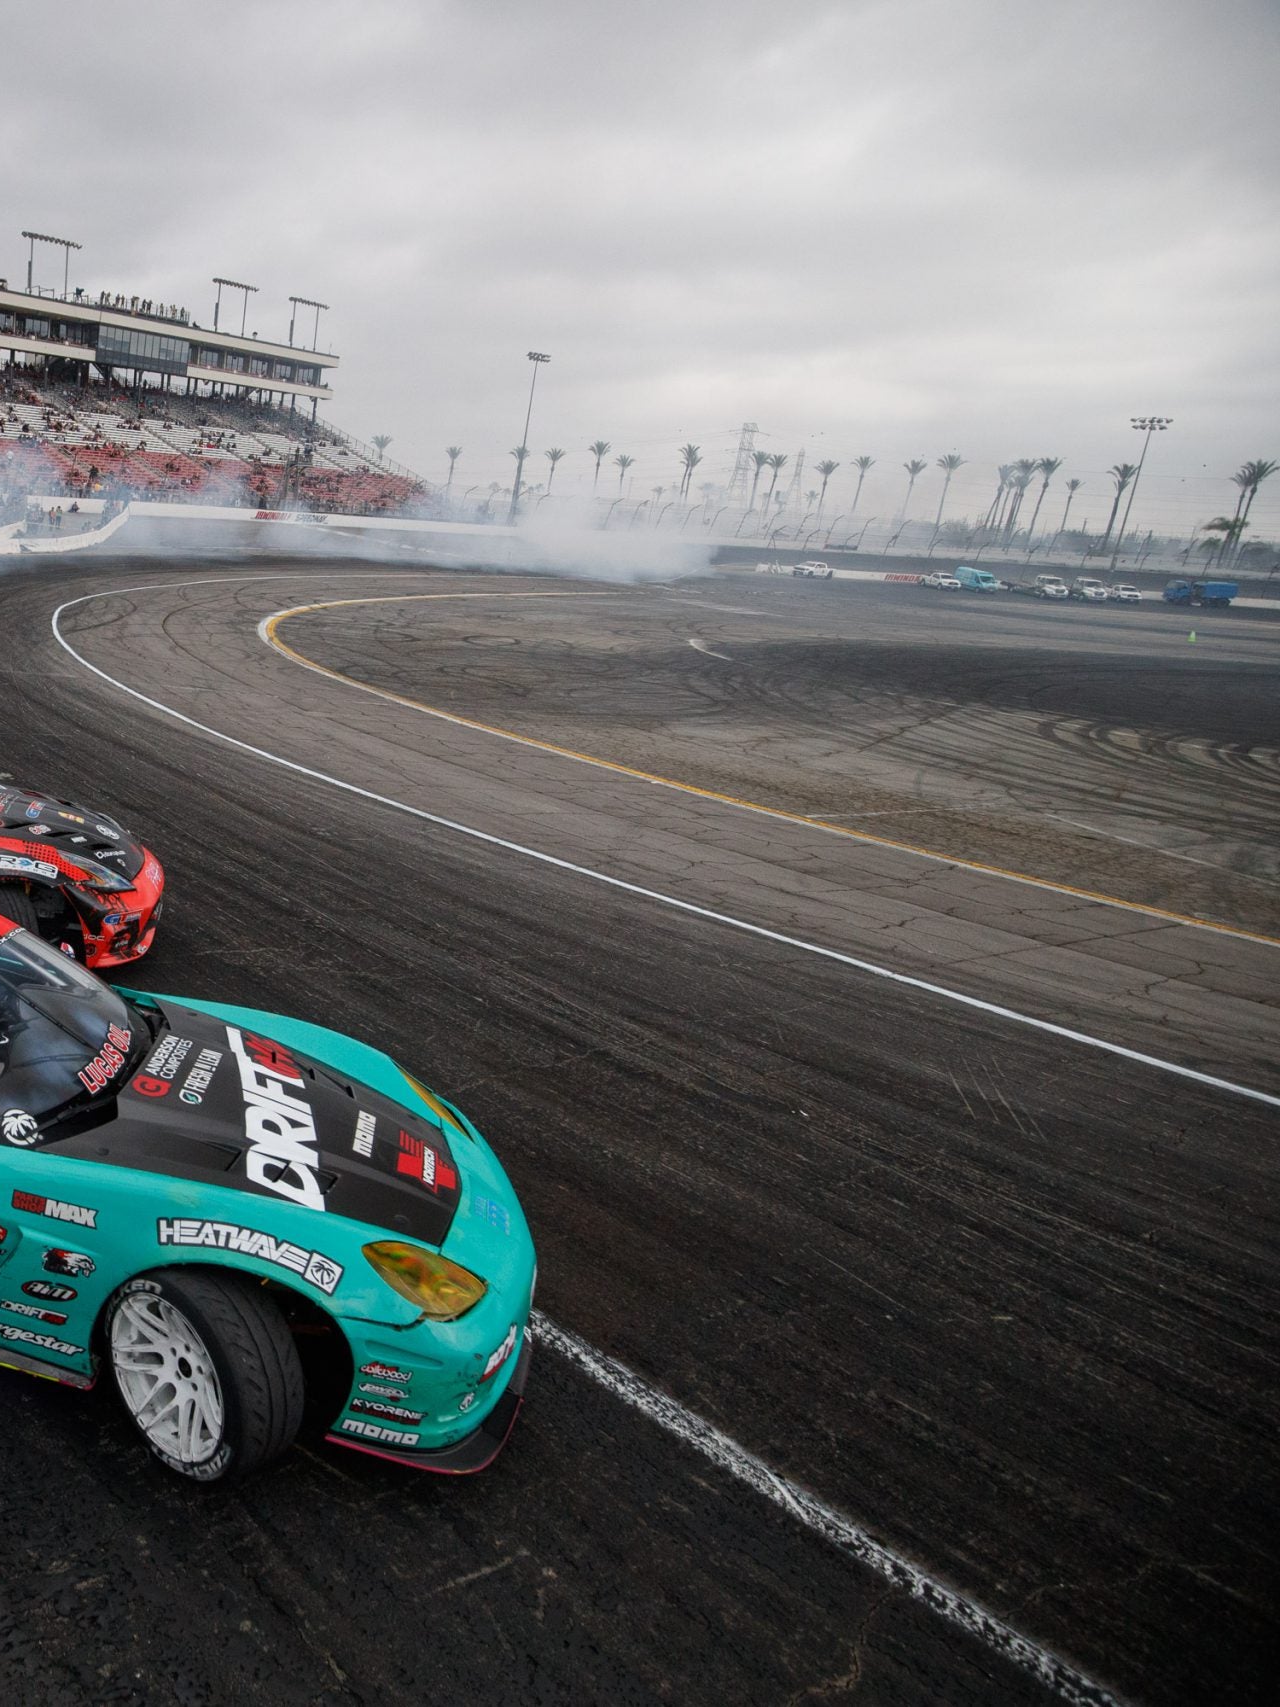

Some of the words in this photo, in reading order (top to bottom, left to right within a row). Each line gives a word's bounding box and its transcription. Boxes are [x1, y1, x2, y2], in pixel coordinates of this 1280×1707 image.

[78, 1042, 125, 1095] LUCAS
[106, 1022, 132, 1052] OIL
[145, 1034, 180, 1076] ANDERSON
[160, 1038, 193, 1079] COMPOSITES
[183, 1066, 213, 1094] FRESH
[202, 1048, 223, 1070] LEAN
[226, 1026, 325, 1212] DRIFT
[422, 1146, 435, 1186] VORTECH
[45, 1199, 97, 1228] MAX
[159, 1219, 310, 1275] HEATWAVE
